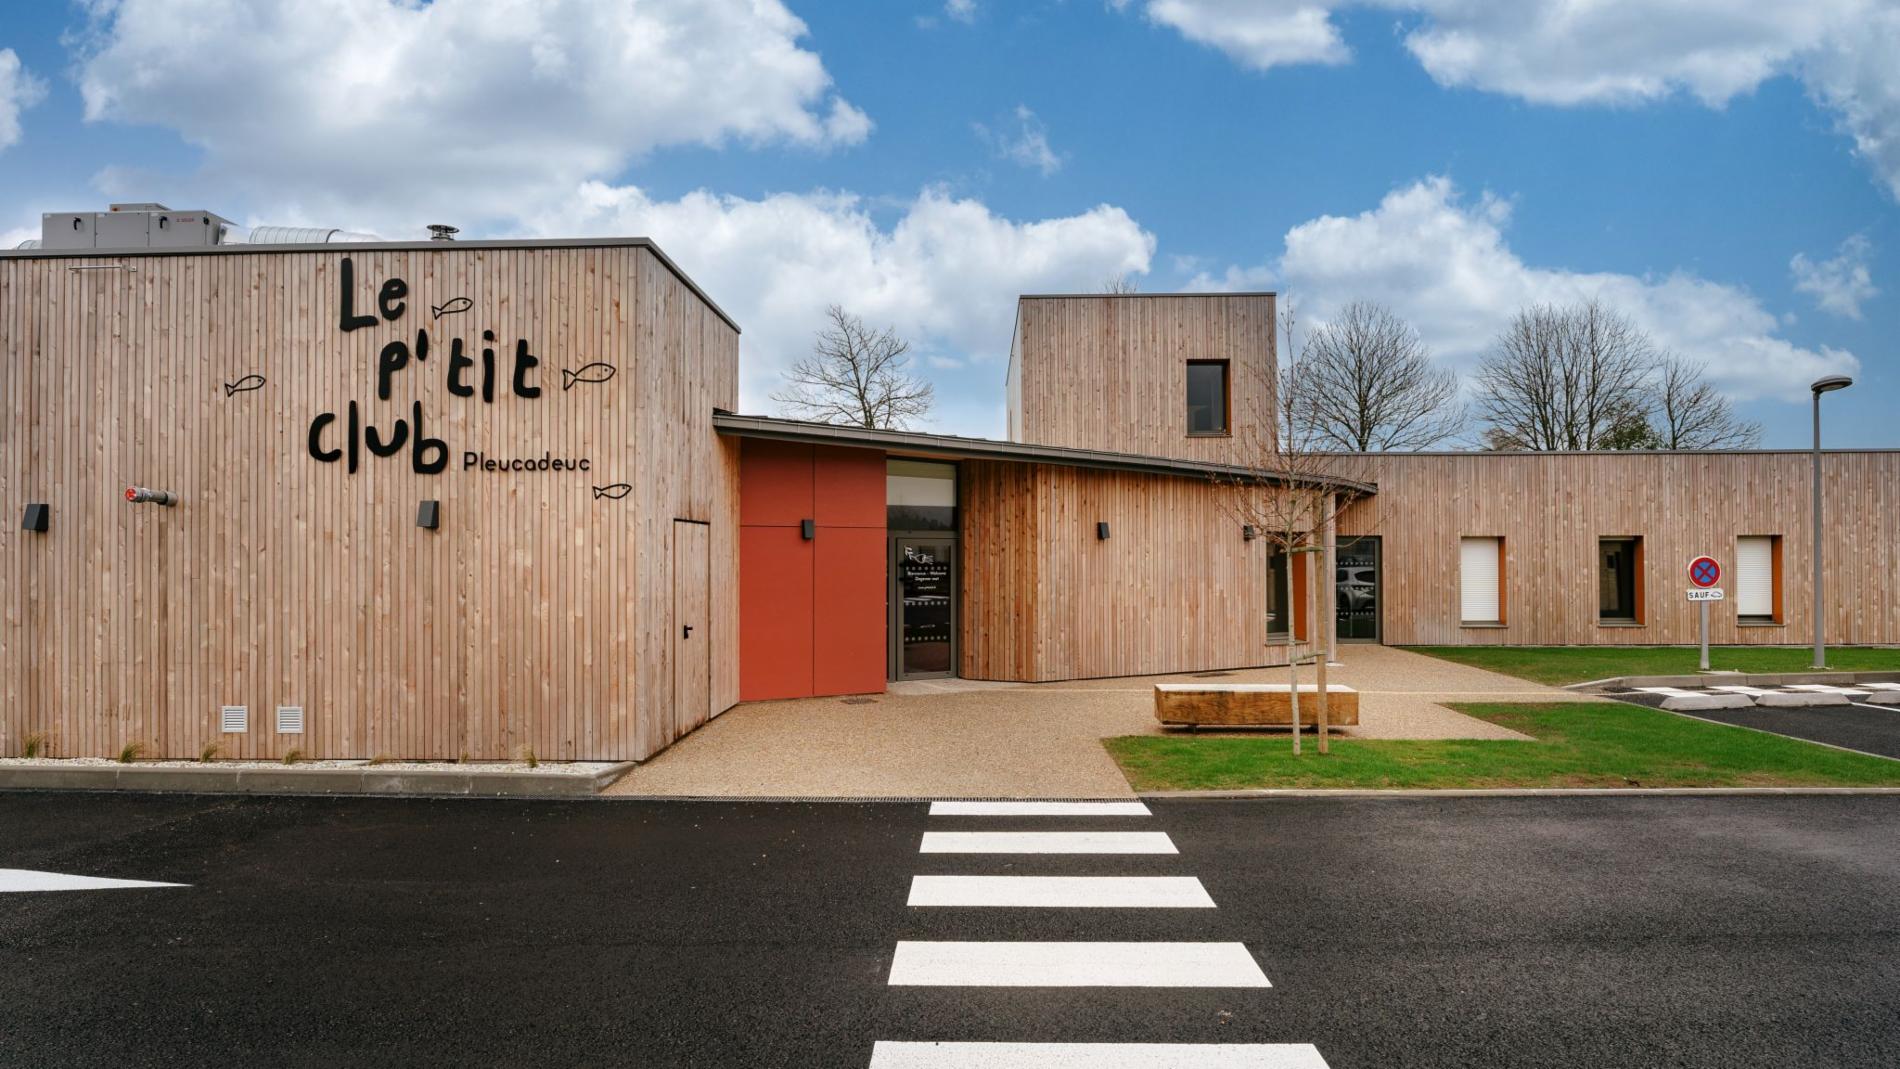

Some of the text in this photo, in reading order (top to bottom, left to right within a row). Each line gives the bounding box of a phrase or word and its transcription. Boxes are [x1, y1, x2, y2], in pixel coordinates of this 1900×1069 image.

[339, 257, 408, 333] Le
[308, 400, 449, 475] club
[463, 451, 591, 473] Pleucadeuc
[1688, 591, 1710, 599] SAUF
